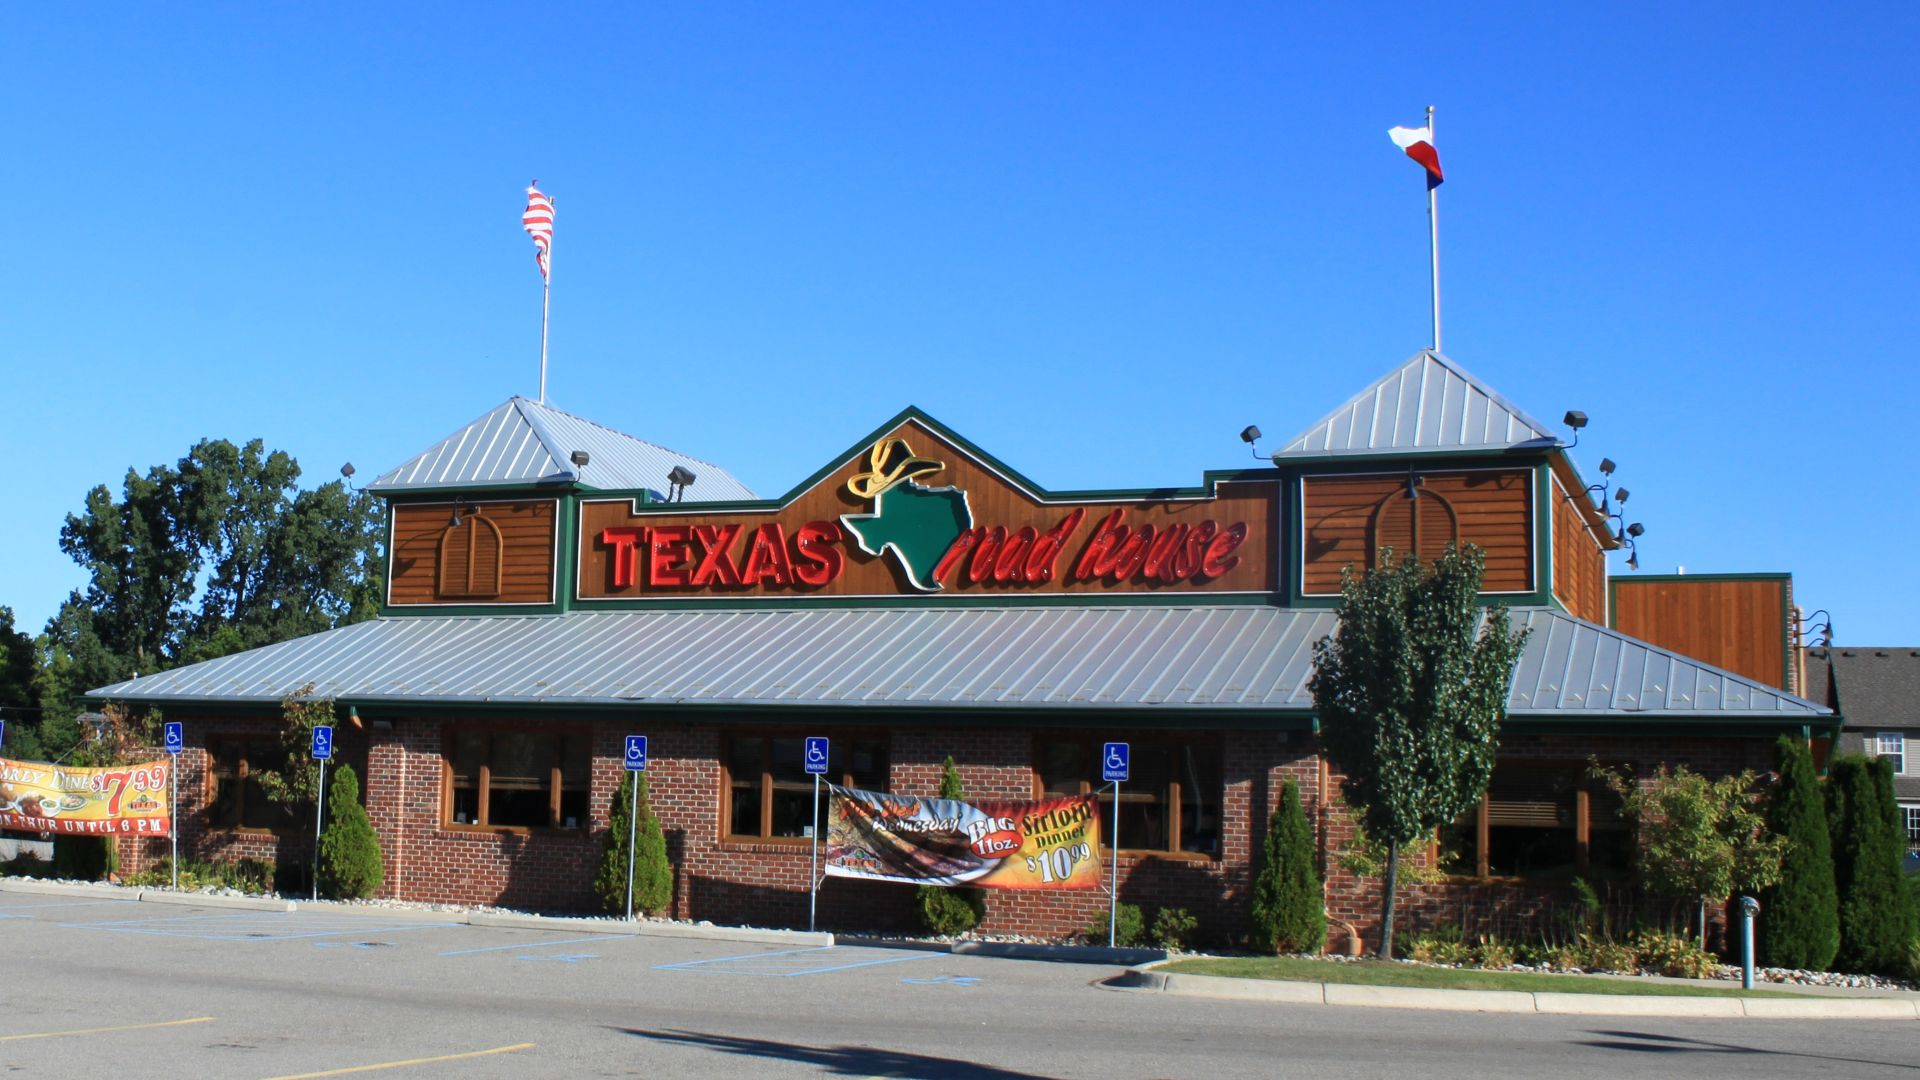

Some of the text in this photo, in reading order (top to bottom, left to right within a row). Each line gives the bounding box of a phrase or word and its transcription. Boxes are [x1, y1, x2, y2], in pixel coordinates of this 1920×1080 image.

[603, 520, 845, 586] TEXAS
[64, 820, 116, 832] UNTIL
[121, 820, 130, 832] 6
[137, 818, 162, 832] PM
[967, 817, 1017, 846] BIG
[1021, 801, 1092, 837] Sirloin
